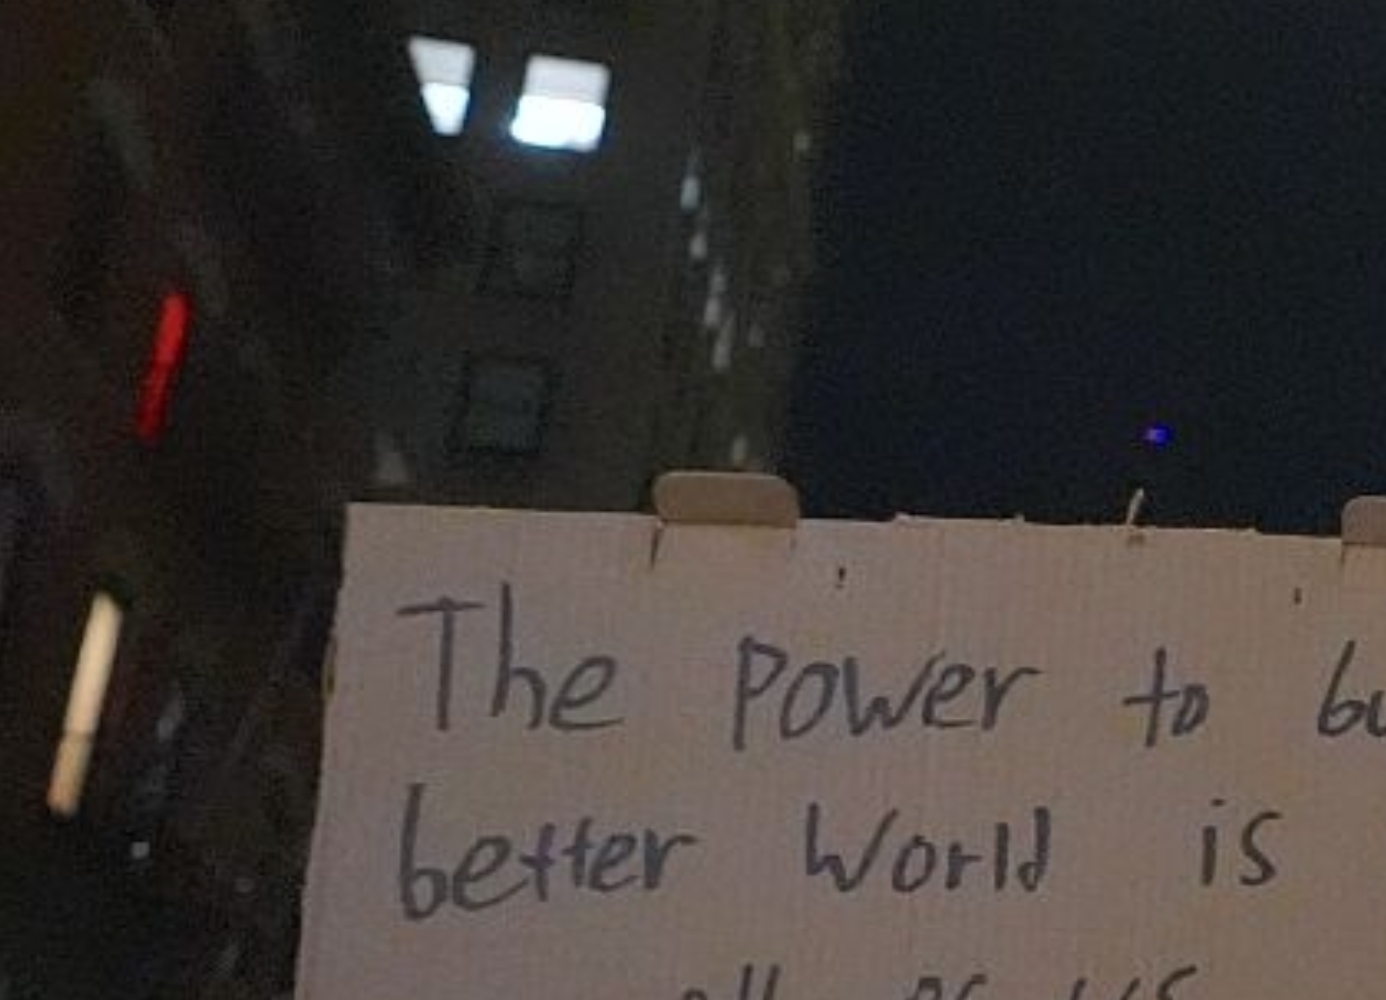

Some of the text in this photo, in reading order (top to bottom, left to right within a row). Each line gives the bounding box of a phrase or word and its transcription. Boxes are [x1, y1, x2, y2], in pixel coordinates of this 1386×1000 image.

[396, 581, 624, 731] The
[1124, 646, 1210, 748] to
[398, 783, 698, 919] better
[1200, 798, 1282, 887] is
